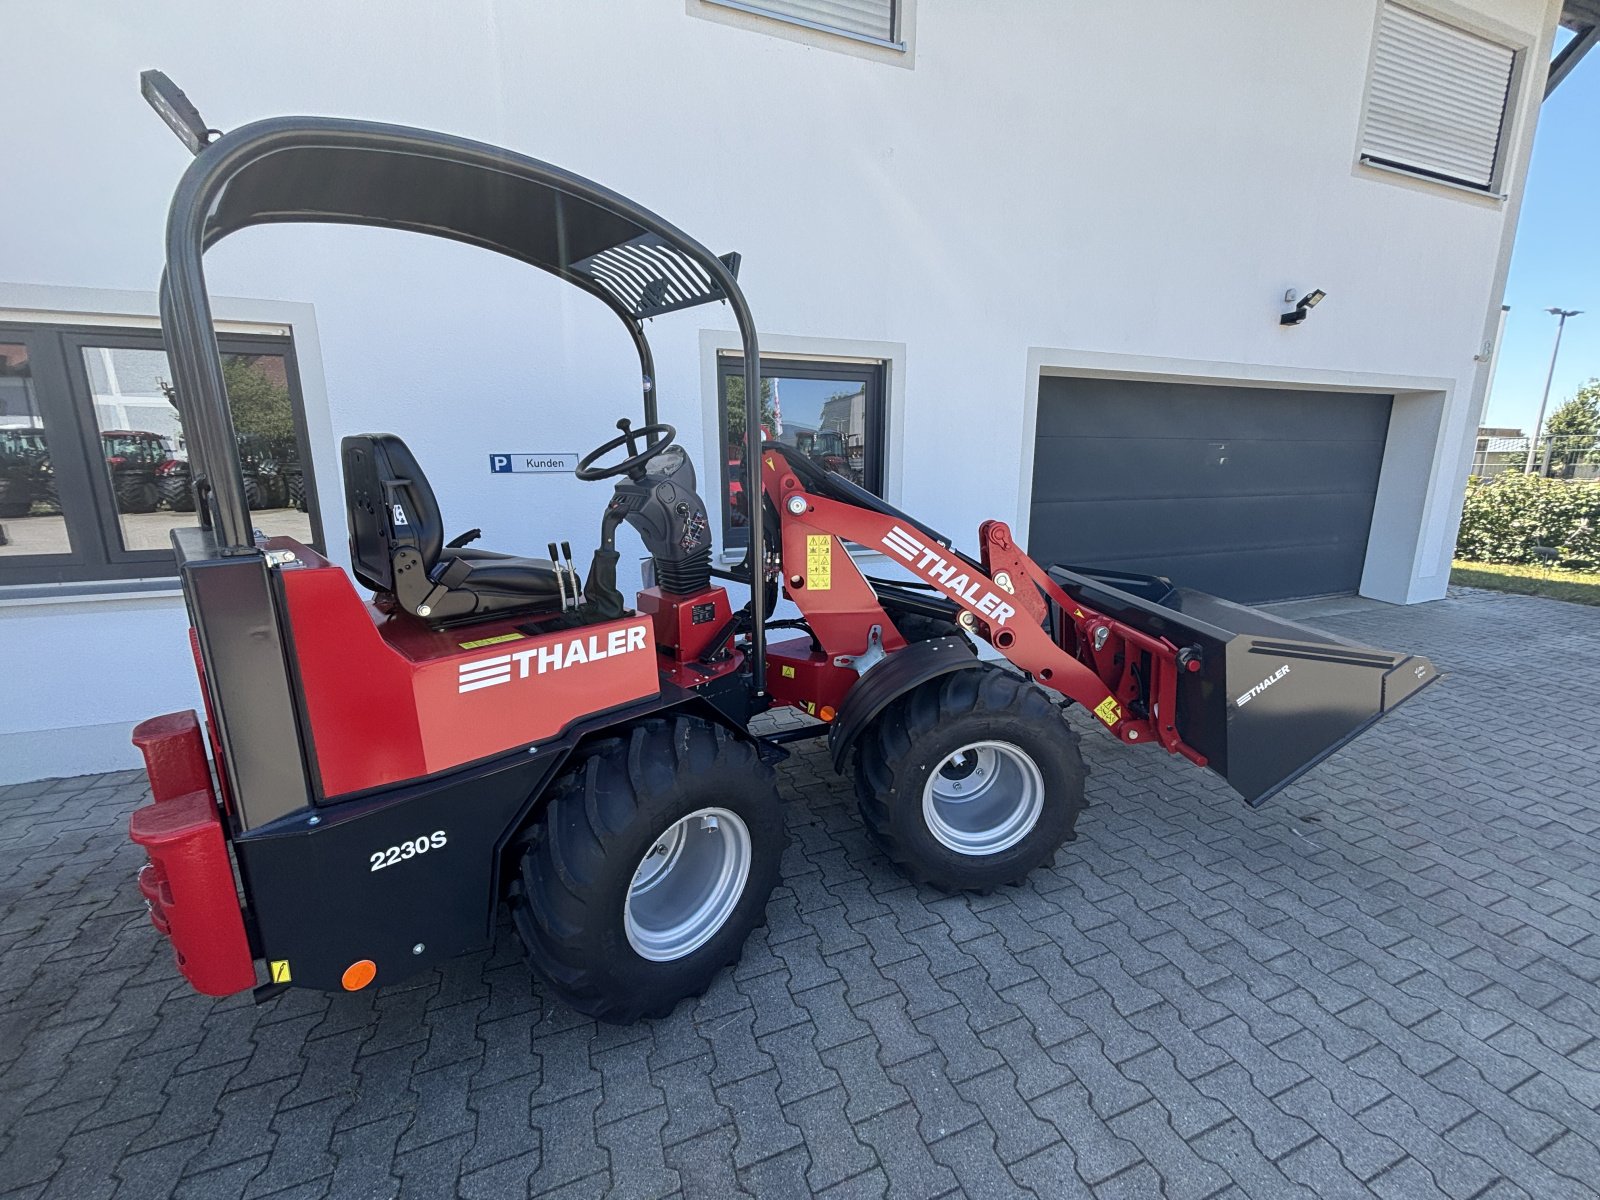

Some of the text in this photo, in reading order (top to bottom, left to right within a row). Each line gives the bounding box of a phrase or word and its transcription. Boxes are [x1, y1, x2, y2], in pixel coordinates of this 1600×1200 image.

[494, 456, 564, 471] P Kunden
[917, 547, 1015, 626] THALER
[512, 625, 646, 679] THALER
[1249, 664, 1290, 697] THALER
[370, 830, 447, 872] 2230S
